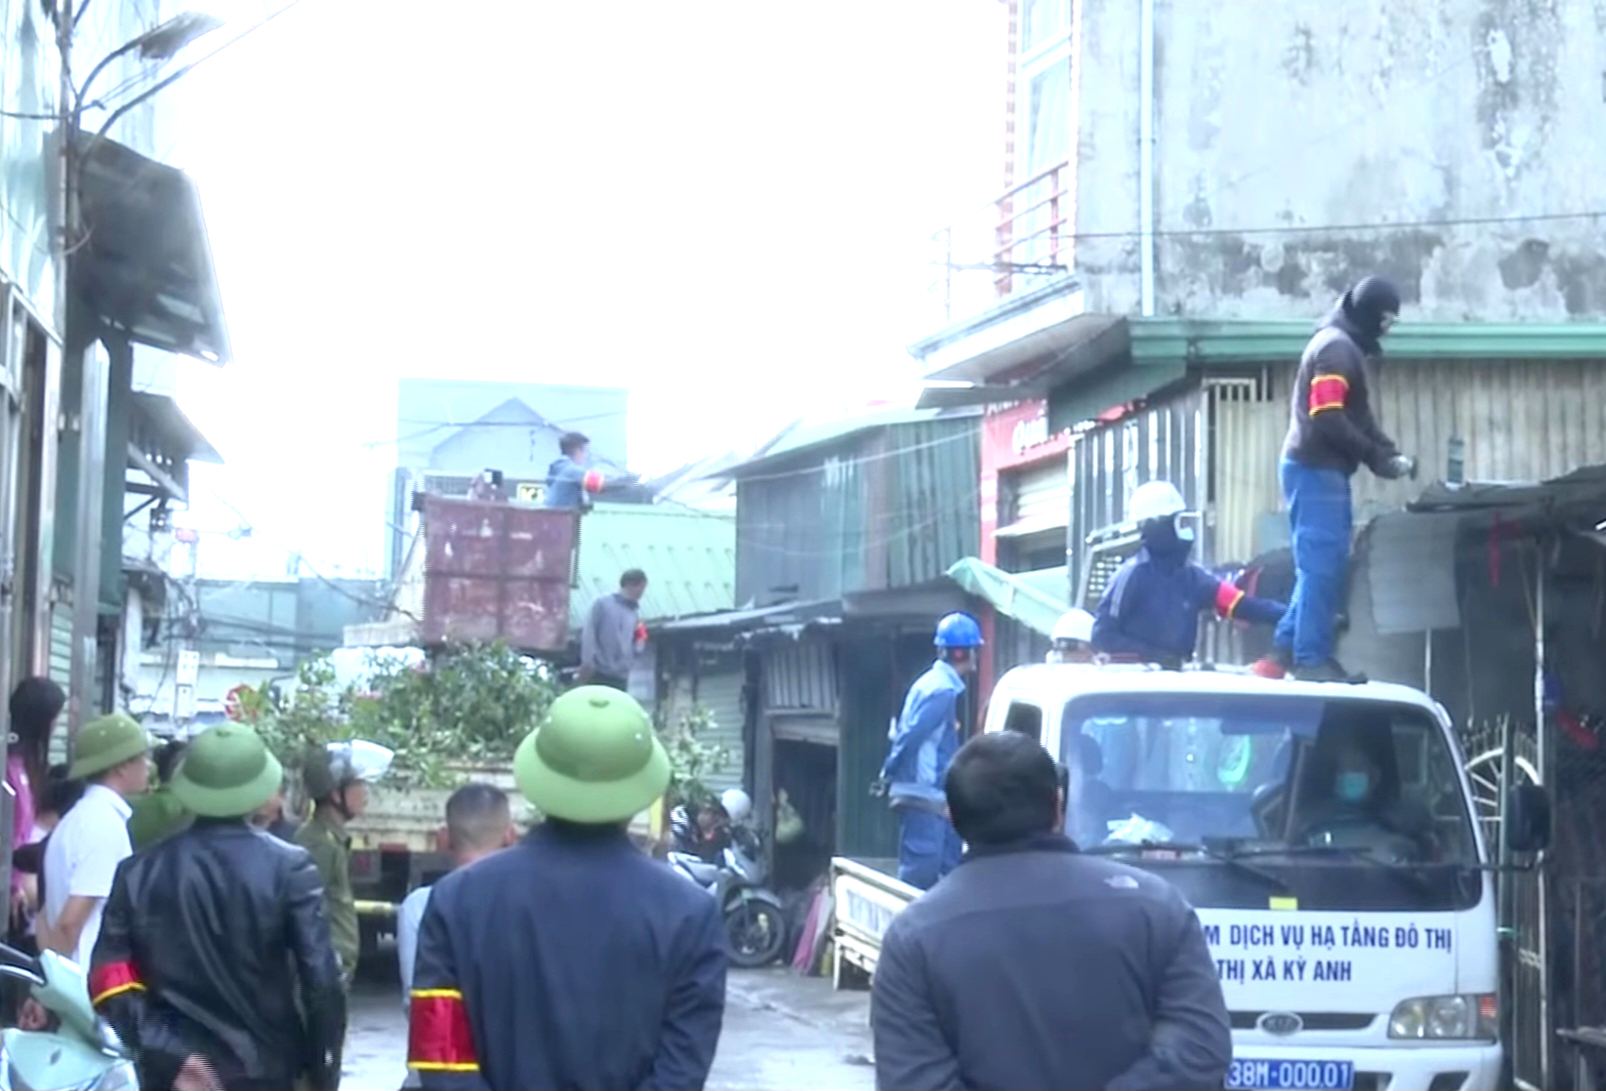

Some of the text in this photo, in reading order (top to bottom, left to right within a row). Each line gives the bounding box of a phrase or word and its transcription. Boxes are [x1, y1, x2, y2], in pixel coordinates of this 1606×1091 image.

[1230, 925, 1274, 950] DỊCH
[1281, 925, 1304, 950] VỤ
[1311, 925, 1336, 950] HẠ
[1341, 918, 1389, 948] TẦNG
[1395, 922, 1419, 949] ĐÔ
[1425, 928, 1452, 954] THỊ
[1217, 960, 1245, 985] THỊ
[1313, 960, 1352, 981] ANH
